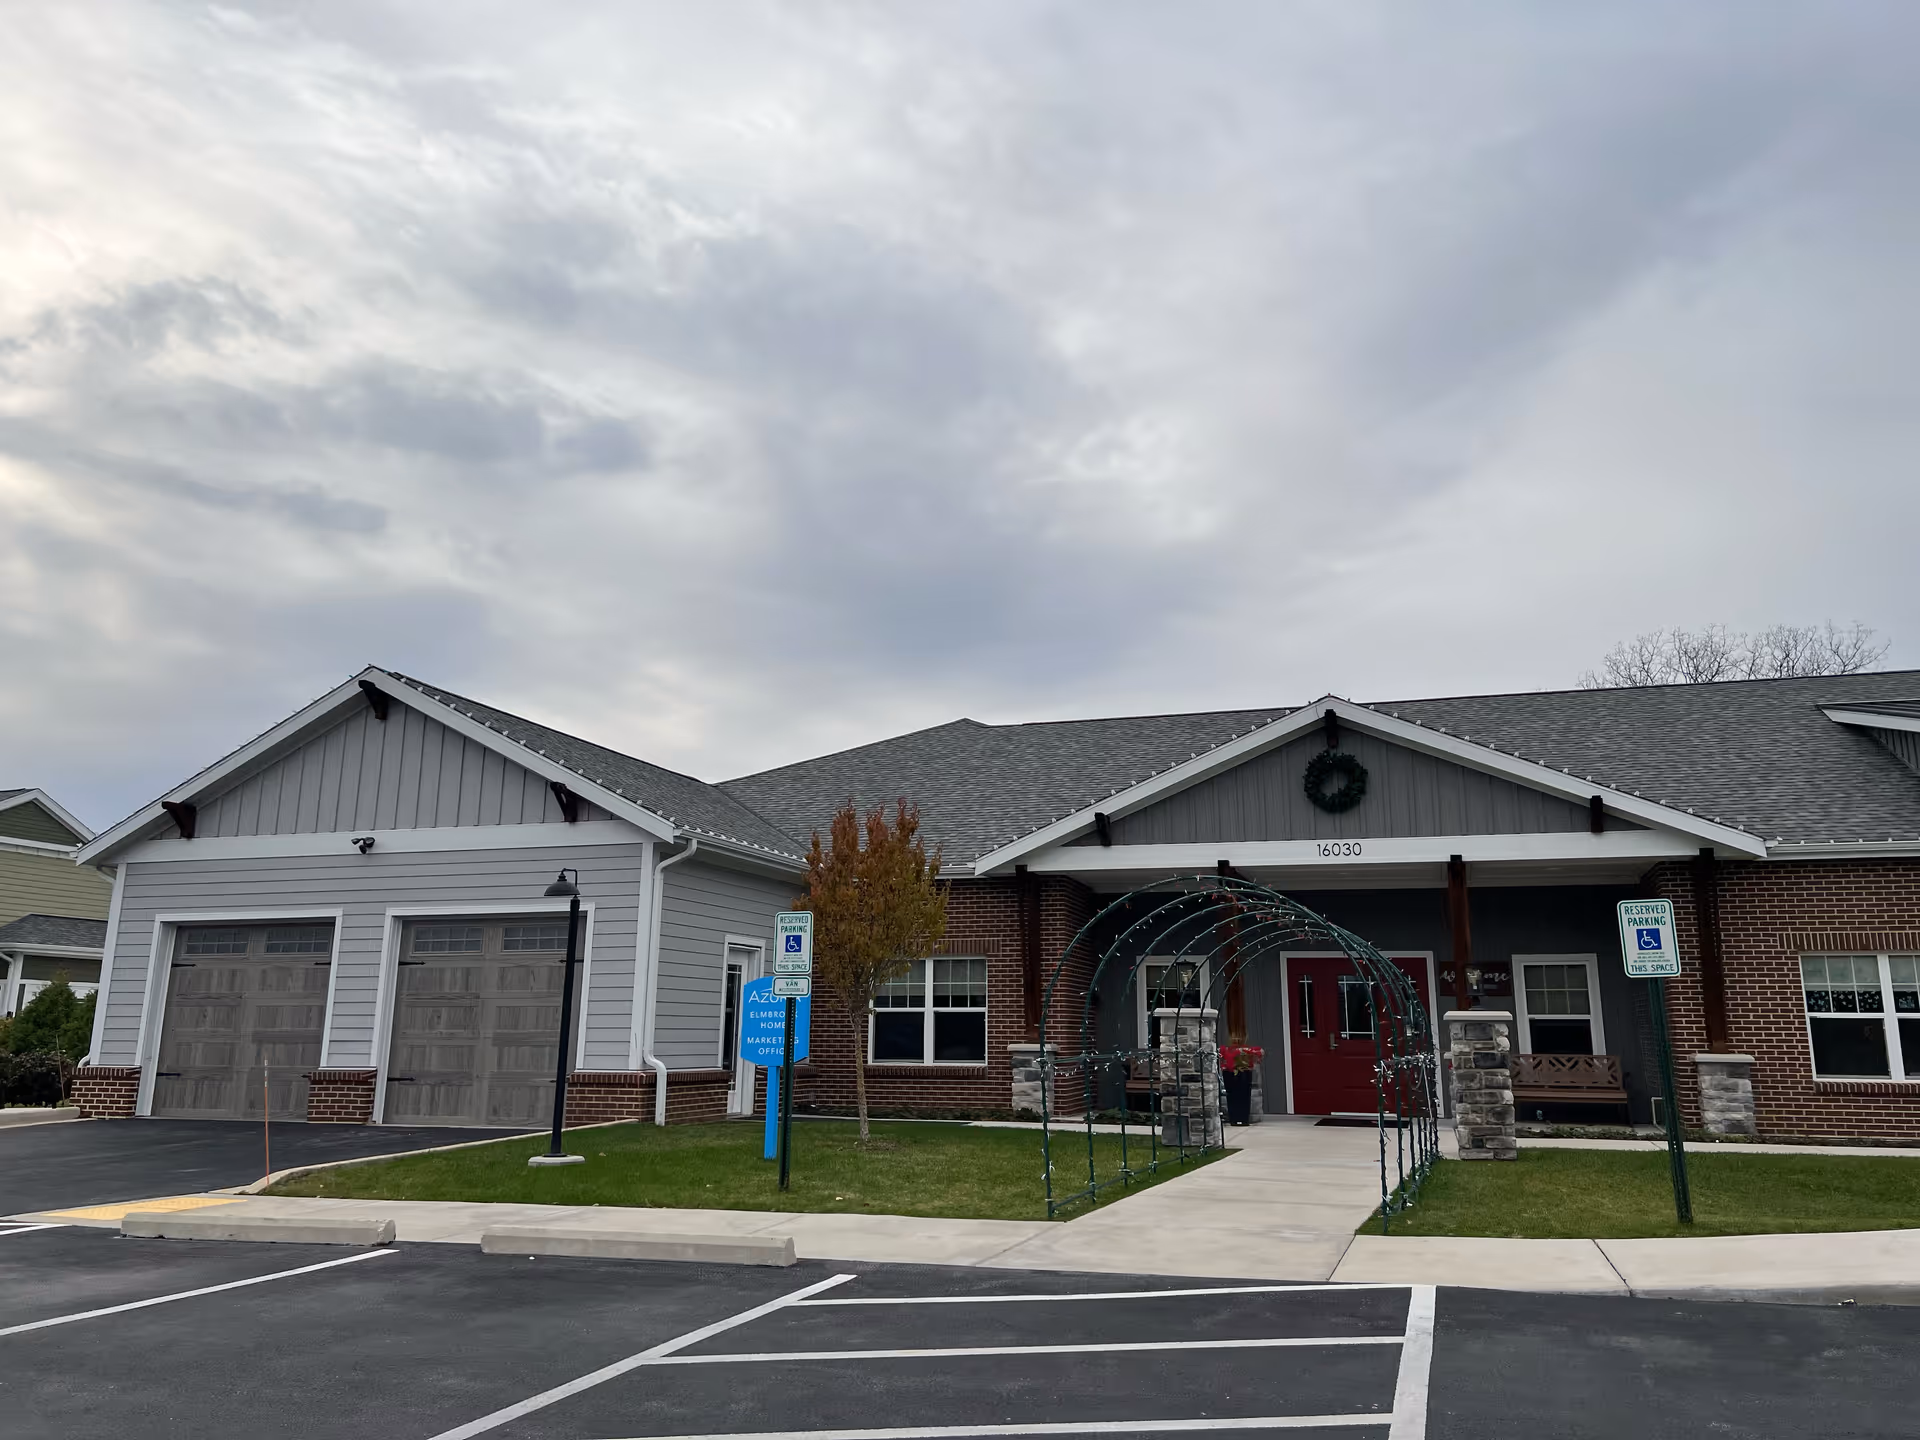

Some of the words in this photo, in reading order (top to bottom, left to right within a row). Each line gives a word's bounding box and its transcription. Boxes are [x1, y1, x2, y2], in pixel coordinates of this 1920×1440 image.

[1316, 842, 1362, 857] 16030
[1624, 904, 1666, 915] RESERVED
[779, 915, 809, 924] RESERVED
[1627, 915, 1666, 927] PARKING
[780, 925, 808, 934] PARKING
[777, 963, 790, 971] THIS
[791, 963, 808, 971] SPACE
[1630, 964, 1648, 973] THIS
[1650, 963, 1675, 972] SPACE
[748, 990, 801, 1003] AZU
[749, 1011, 798, 1019] ELMBRO
[747, 1036, 799, 1045] MARKETIG
[758, 1047, 785, 1055] OFFIC
